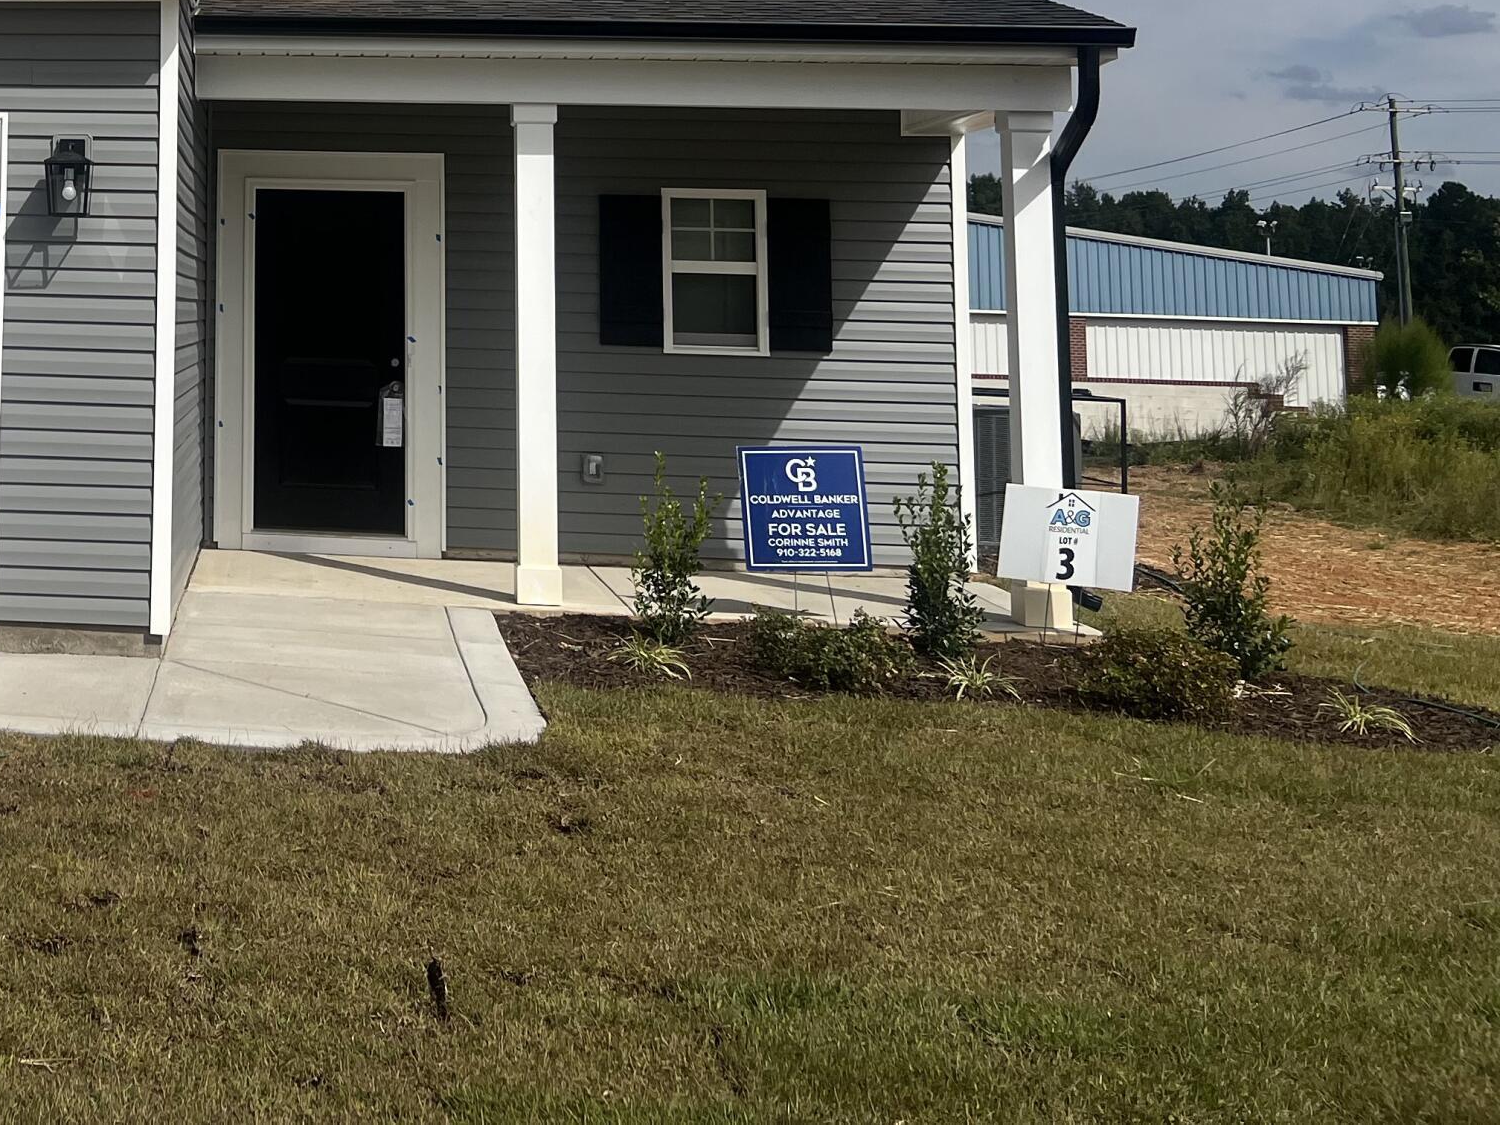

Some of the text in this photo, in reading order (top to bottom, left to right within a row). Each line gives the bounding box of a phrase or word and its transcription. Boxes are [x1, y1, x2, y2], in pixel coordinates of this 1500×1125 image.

[750, 495, 858, 504] COLDWELL BANKER
[771, 509, 841, 518] ADVANTAGE
[1050, 508, 1091, 527] A&G
[768, 523, 847, 536] FOR SALE
[1048, 526, 1090, 535] RESIDENTIAL
[768, 538, 849, 547] CORINNE SMITH
[1059, 537, 1079, 545] LOT #
[776, 548, 842, 557] 910-322-5168
[1055, 547, 1075, 580] 3
